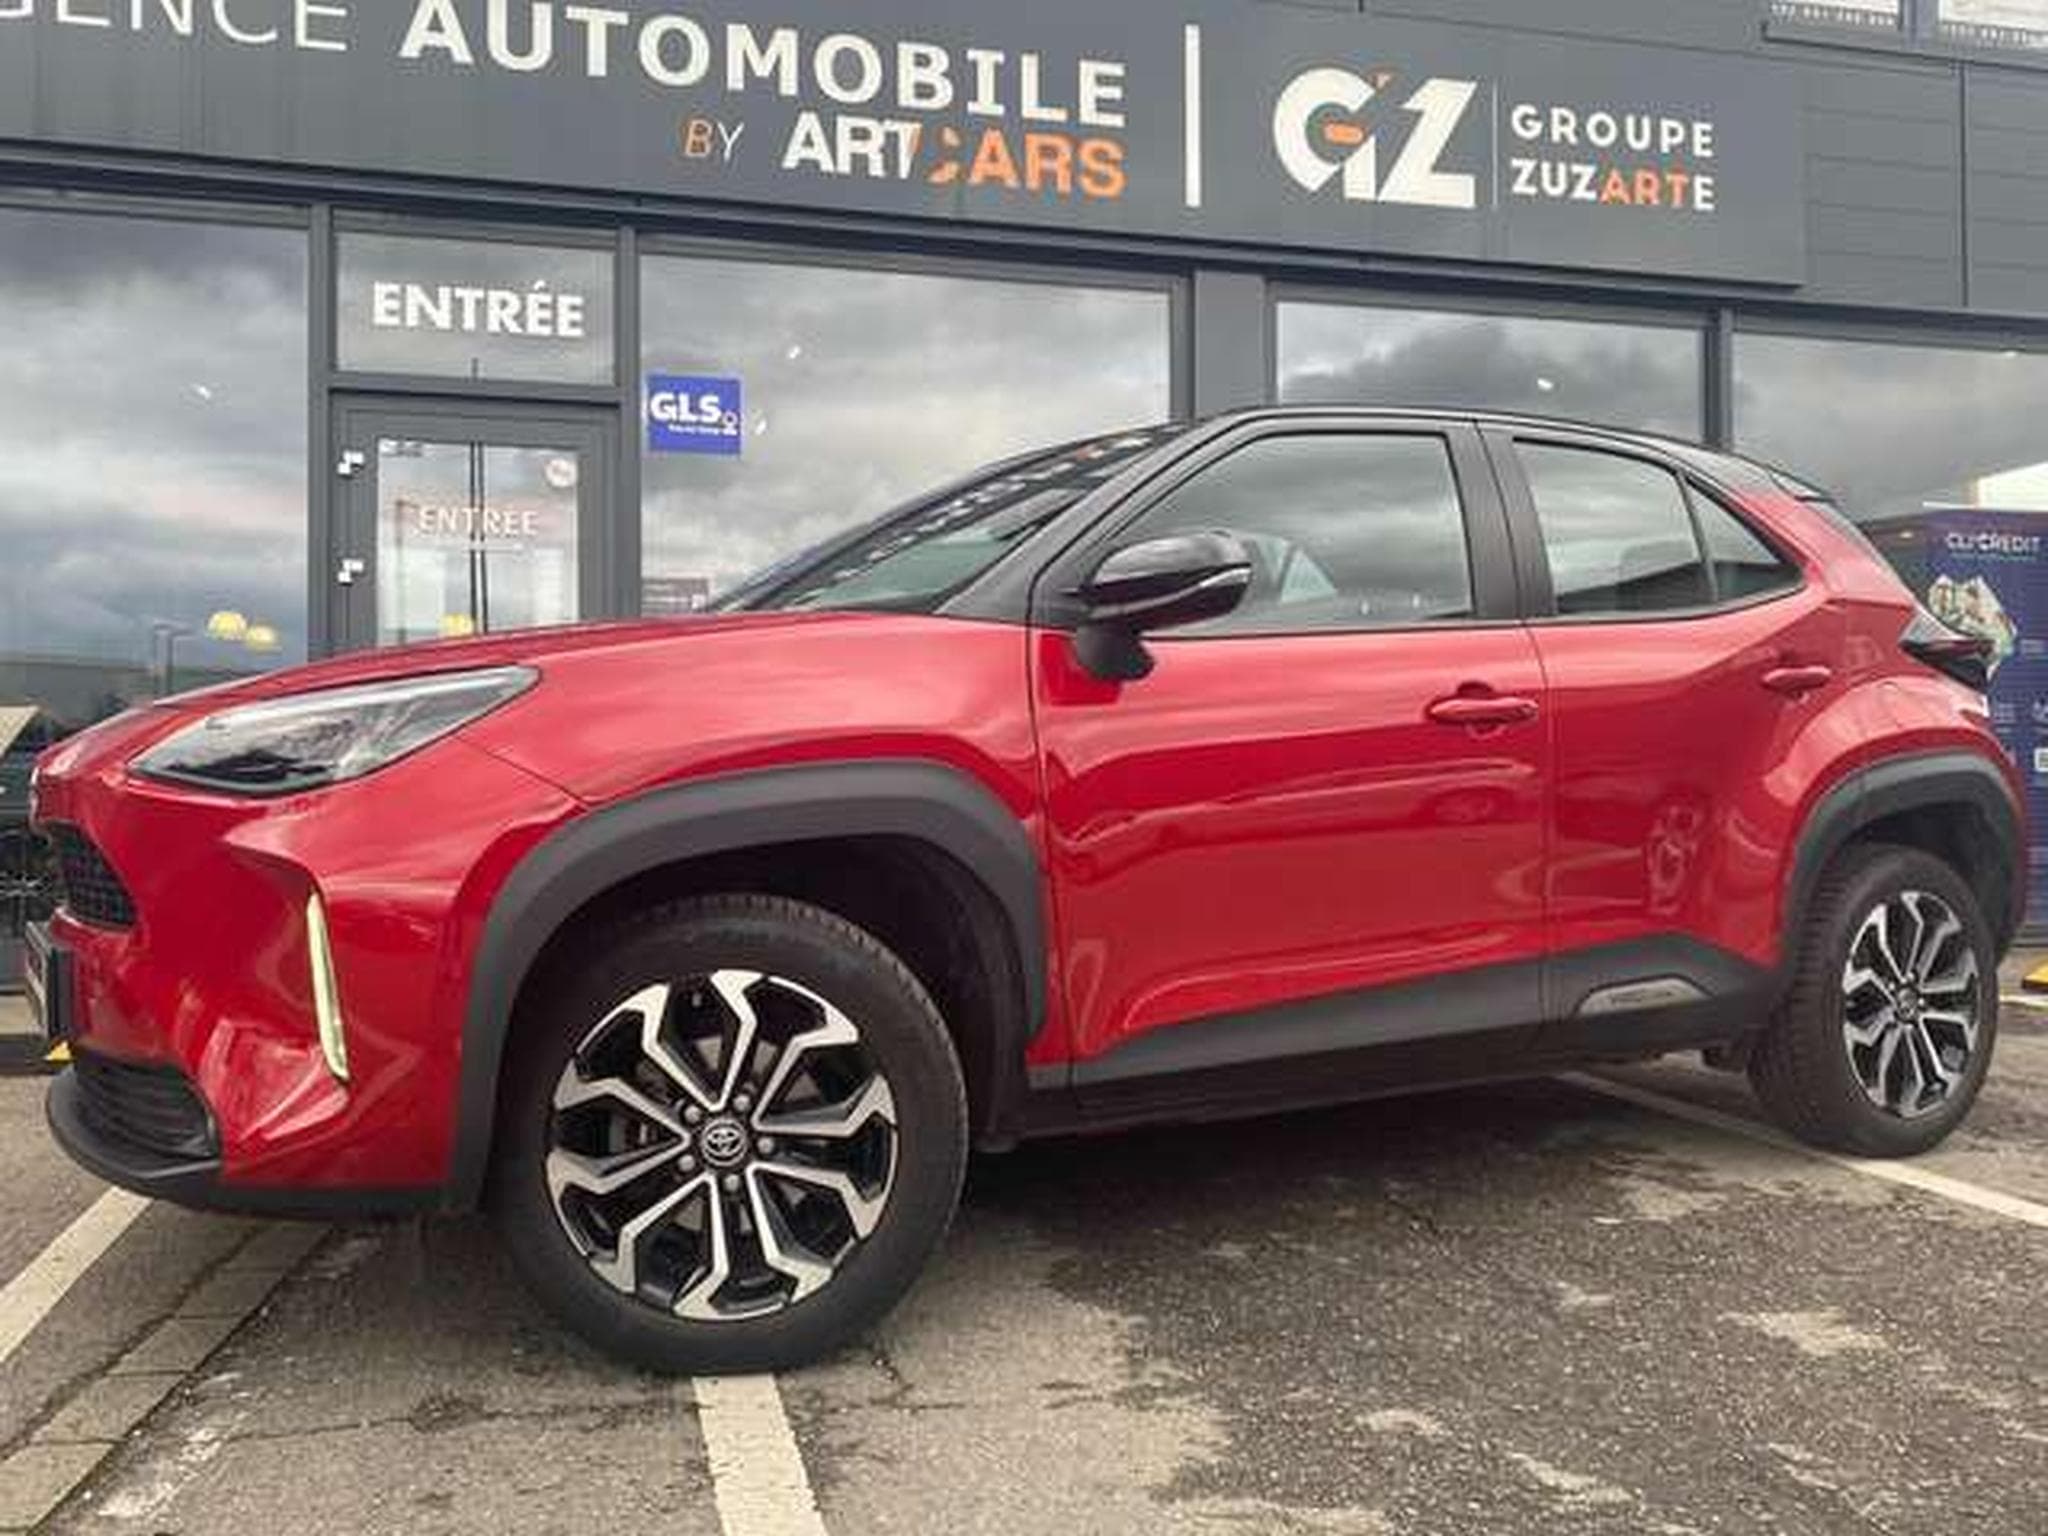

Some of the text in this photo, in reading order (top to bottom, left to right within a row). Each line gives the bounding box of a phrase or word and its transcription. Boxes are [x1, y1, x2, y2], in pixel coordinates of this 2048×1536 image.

[398, 0, 1126, 128] AUTOMOBILE
[684, 118, 744, 162] BY
[1511, 104, 1714, 157] GROUPE
[1511, 158, 1714, 211] ZUZARTE
[371, 279, 585, 337] ENTRÉE
[650, 391, 721, 423] GLS
